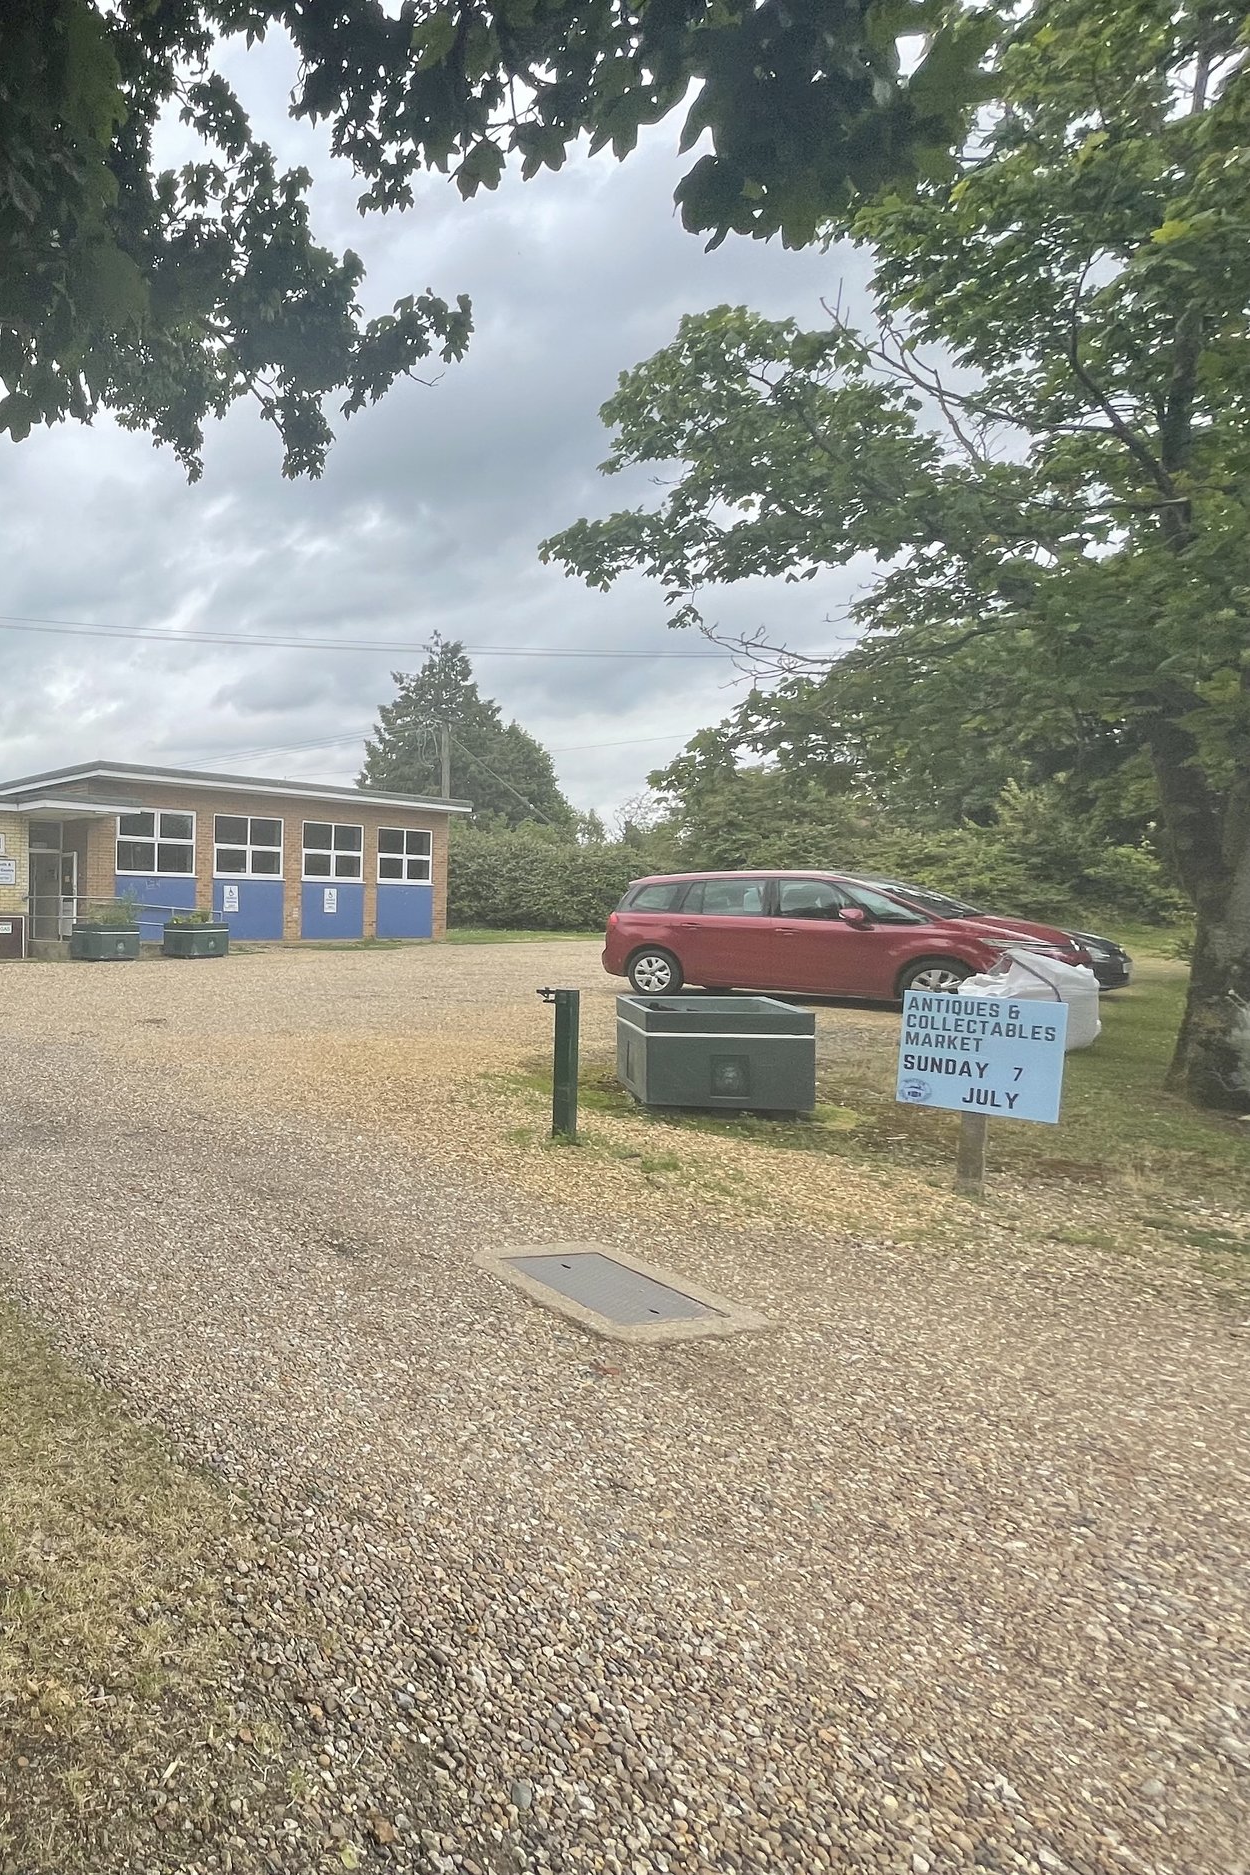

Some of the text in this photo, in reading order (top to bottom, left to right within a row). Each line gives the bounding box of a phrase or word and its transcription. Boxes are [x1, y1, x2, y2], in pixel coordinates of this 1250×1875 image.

[908, 996, 1021, 1020] ANTIQUES &
[906, 1013, 1056, 1042] COLLECTABLES
[904, 1030, 983, 1052] MARKET
[903, 1054, 1023, 1082] SUNDAY 7
[962, 1087, 1020, 1110] JULY
